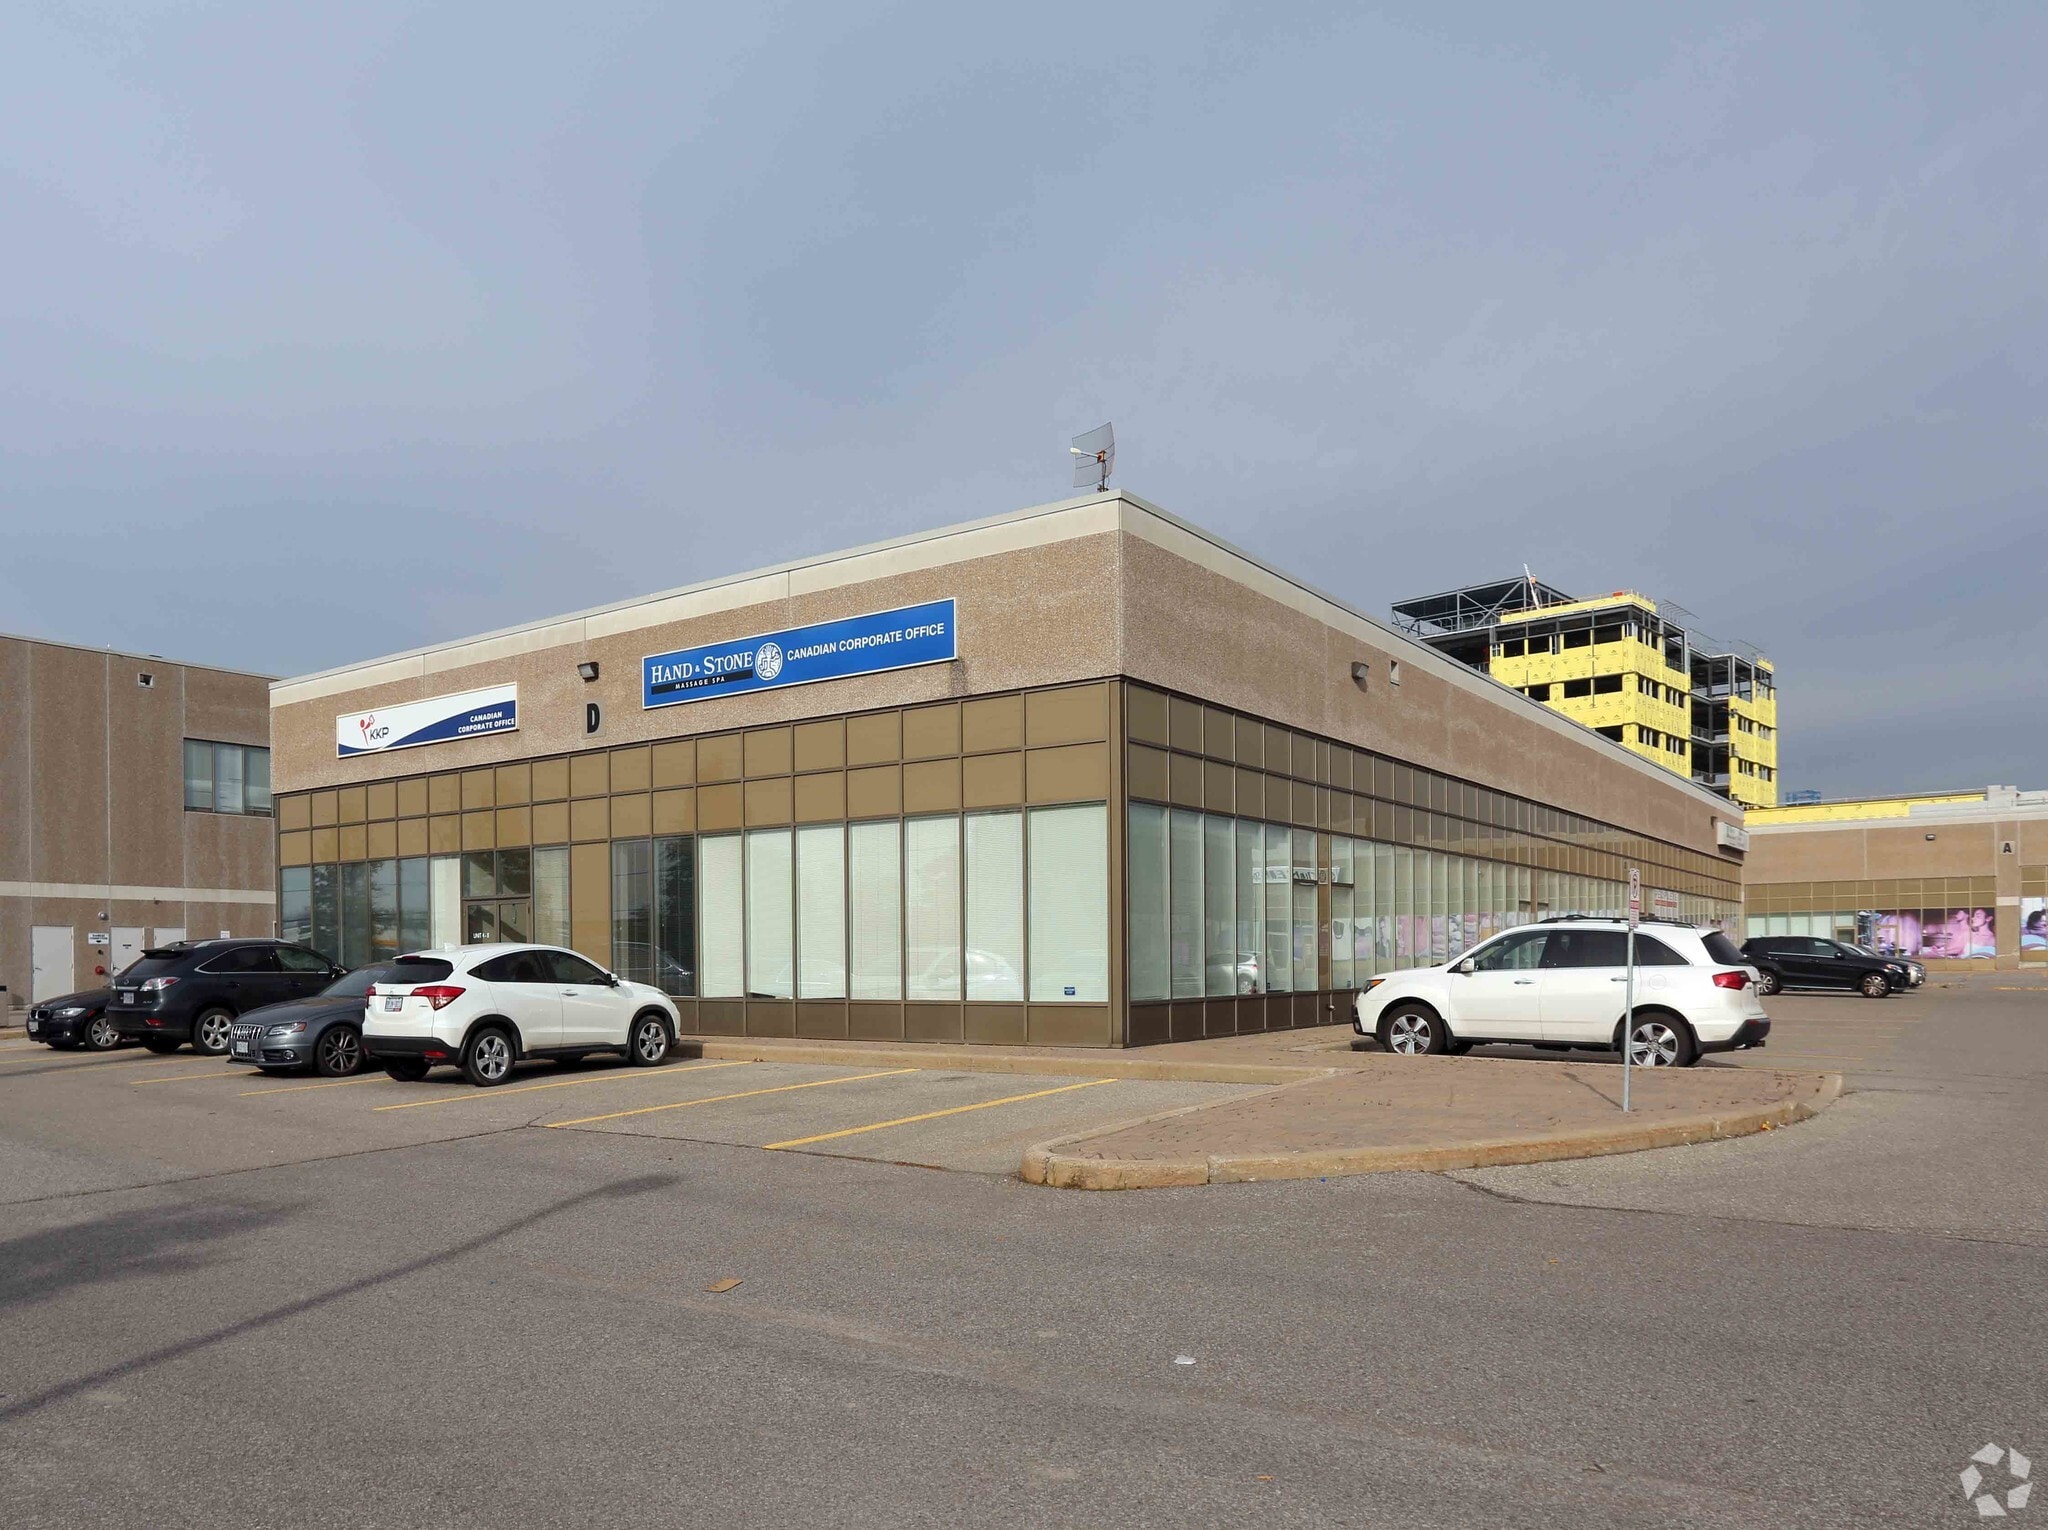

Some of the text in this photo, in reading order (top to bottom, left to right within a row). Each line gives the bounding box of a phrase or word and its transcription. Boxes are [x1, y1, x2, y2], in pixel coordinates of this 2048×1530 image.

[787, 622, 945, 661] CANADIAN CORPORATE OFFICE
[651, 651, 753, 684] HAND & STONE
[675, 679, 709, 690] MASSAGE
[469, 711, 503, 723] CANADIAN
[586, 702, 600, 734] D
[369, 726, 390, 741] KKP
[457, 717, 515, 734] CORPORATE OFFICE
[2002, 842, 2013, 854] A
